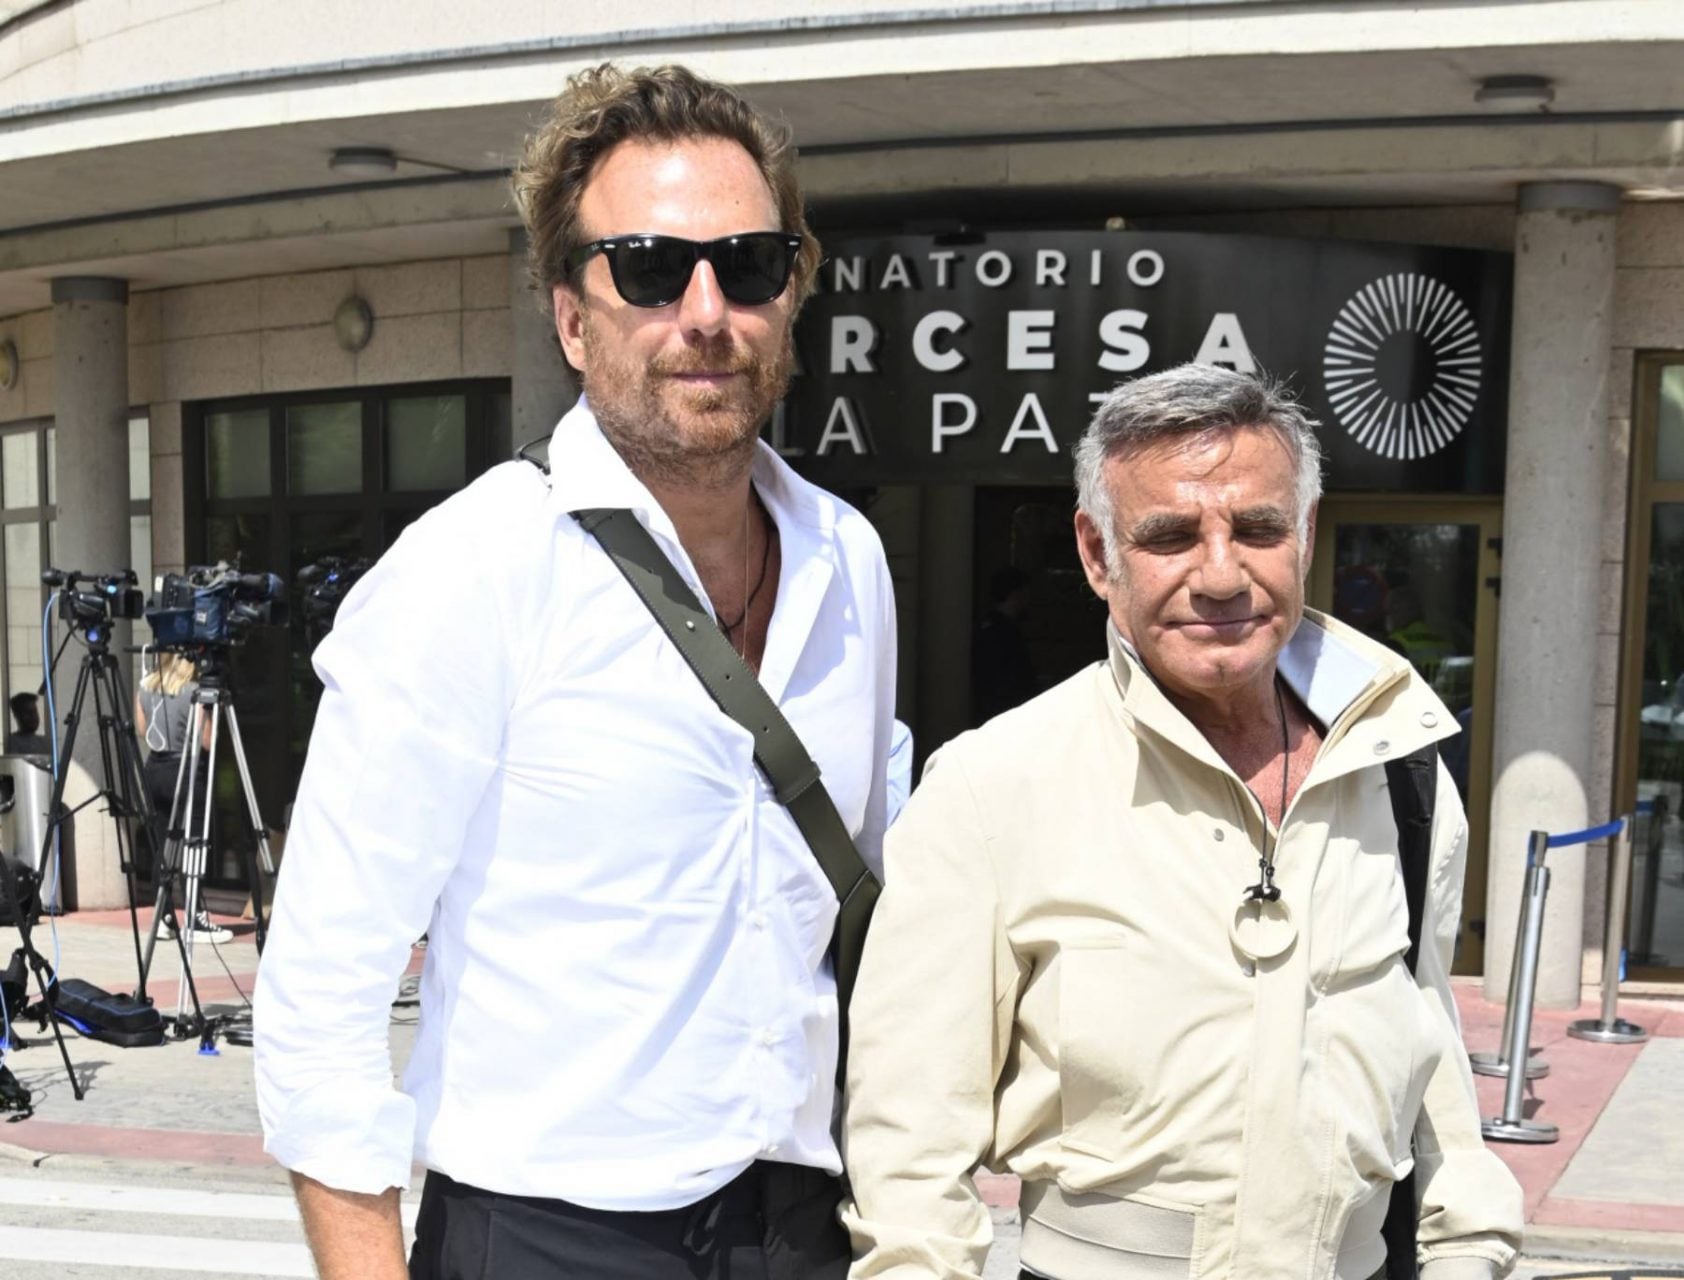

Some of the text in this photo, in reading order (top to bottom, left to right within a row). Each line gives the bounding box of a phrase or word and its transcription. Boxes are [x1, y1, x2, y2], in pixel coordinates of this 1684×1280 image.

[834, 249, 1166, 292] NATORIO
[791, 308, 1258, 375] RCESA
[772, 391, 1113, 456] LA PA
